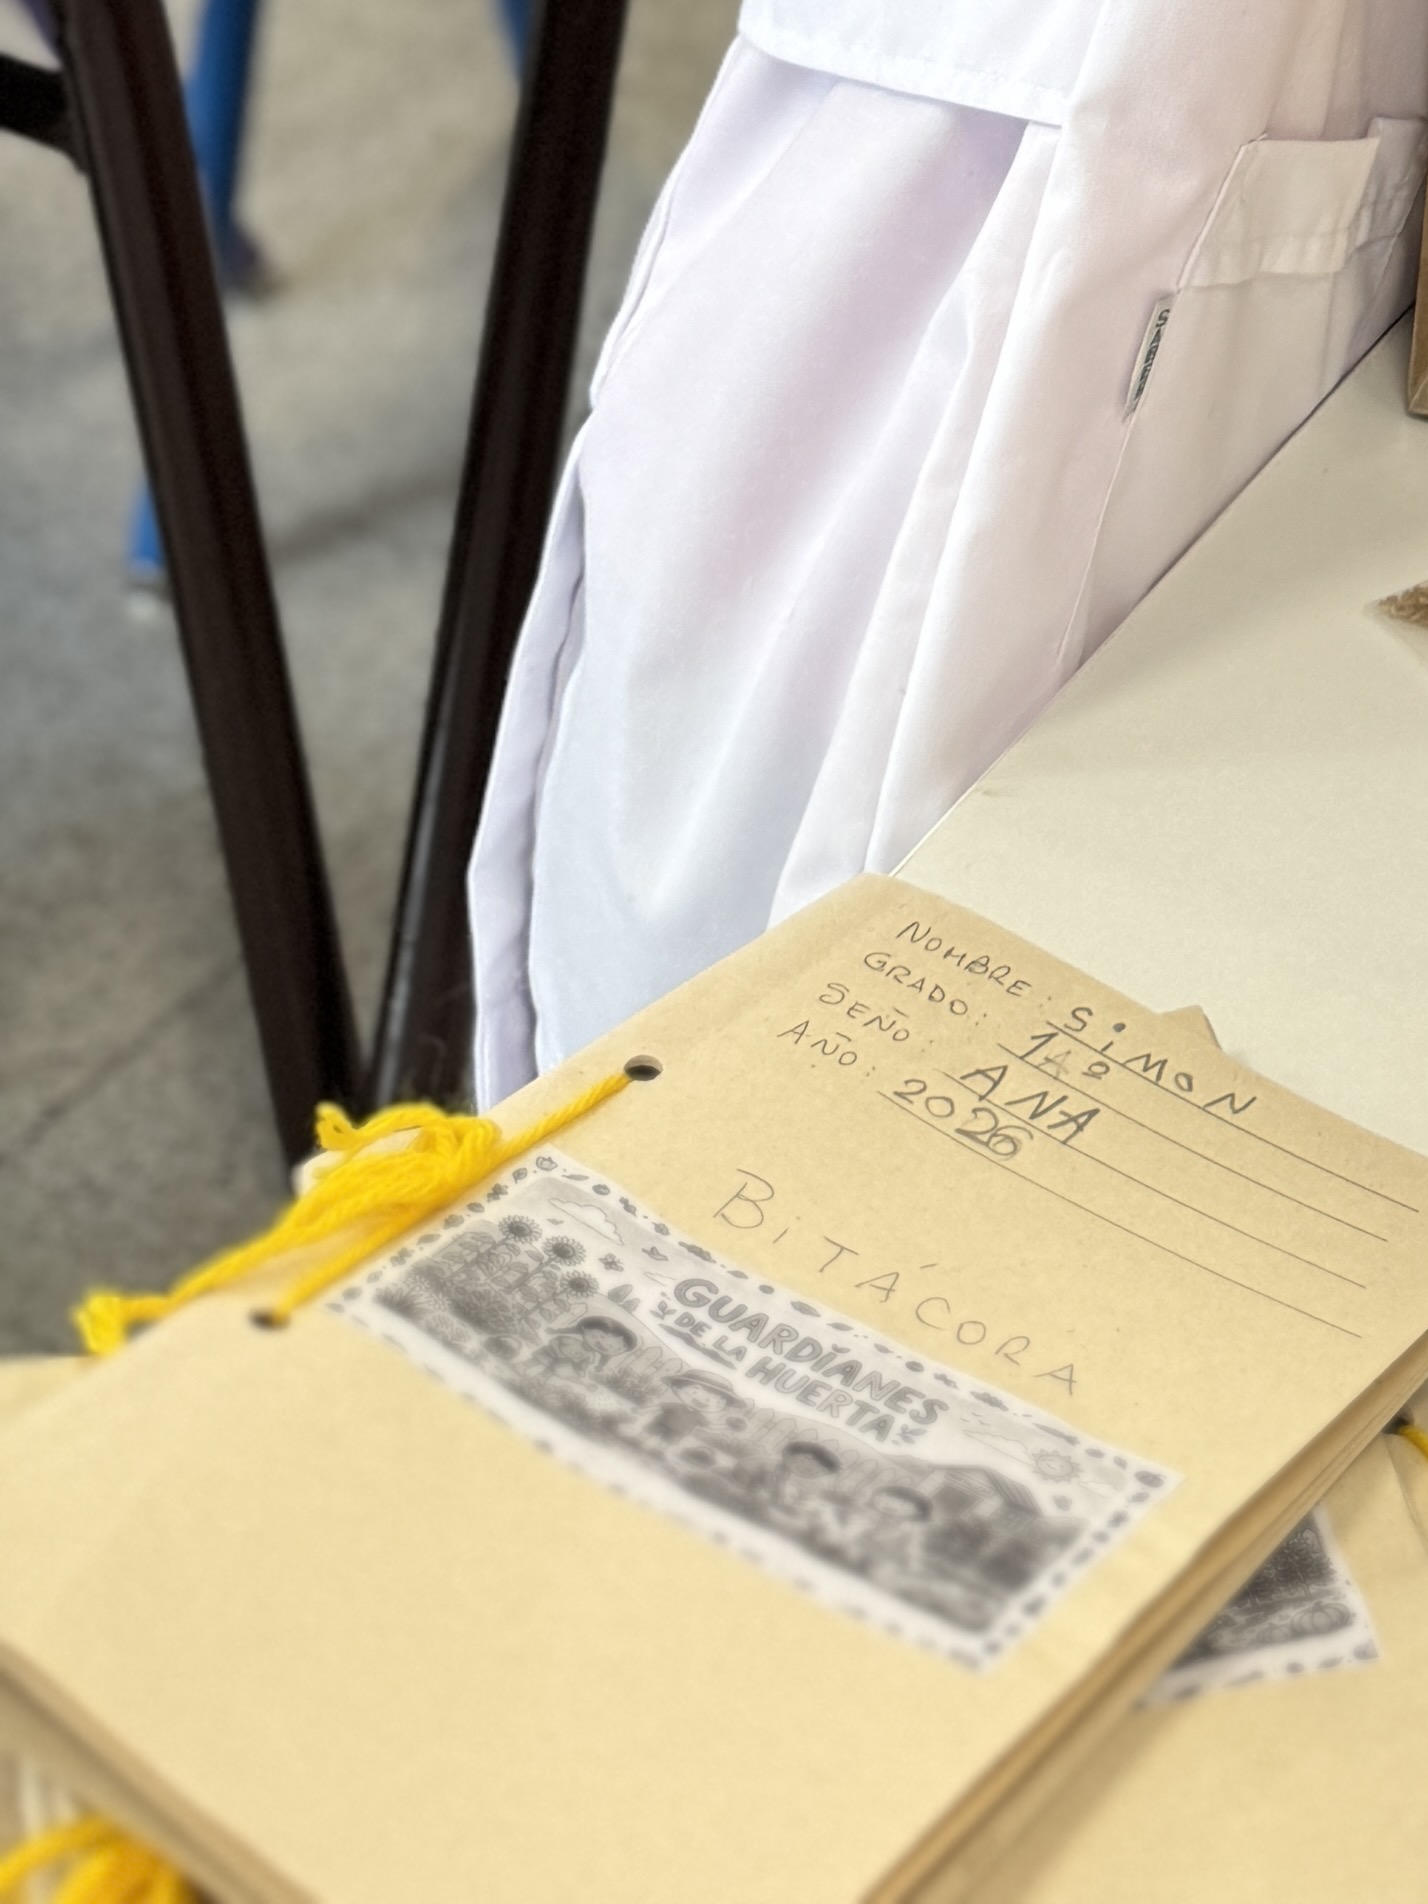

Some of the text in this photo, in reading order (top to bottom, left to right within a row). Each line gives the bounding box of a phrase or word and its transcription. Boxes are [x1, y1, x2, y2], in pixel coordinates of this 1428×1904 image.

[892, 1077, 1034, 1161] 2026
[960, 1063, 1101, 1145] ANA
[673, 1277, 950, 1425] GUARDIANES
[674, 1311, 746, 1363] DE LA
[744, 1354, 898, 1443] HUERTA
